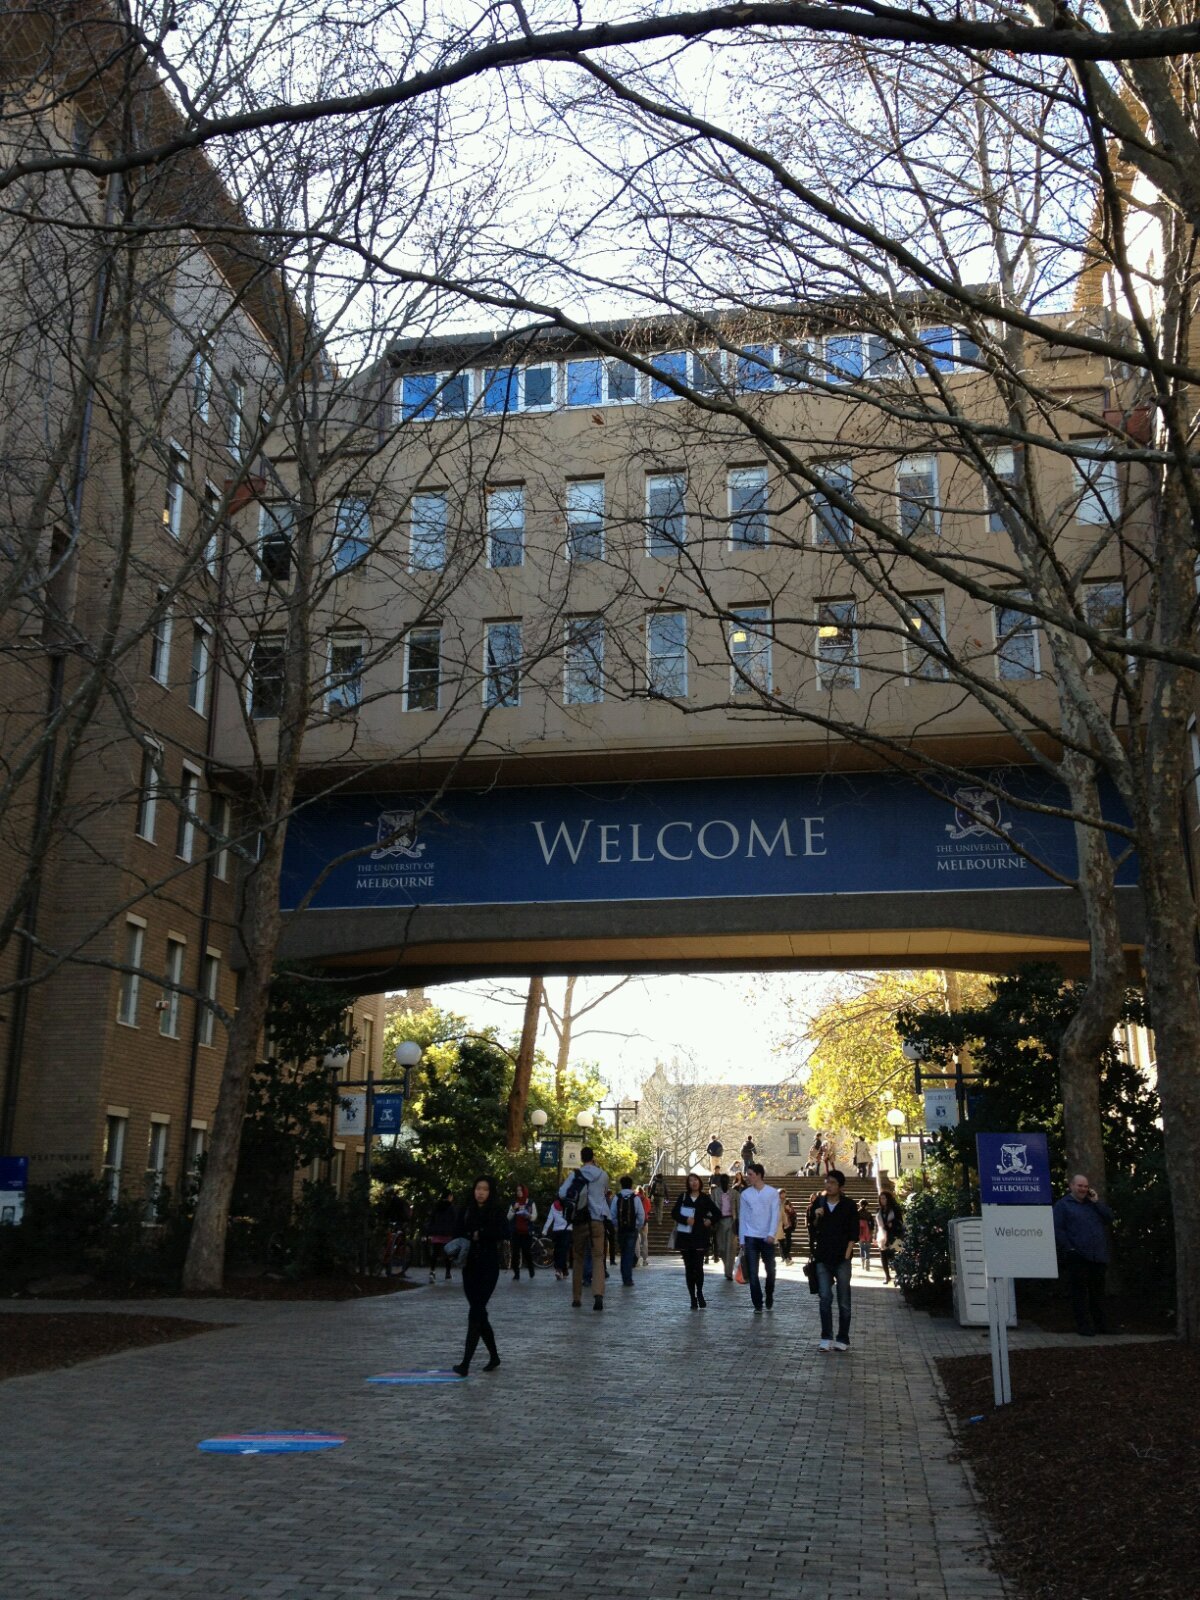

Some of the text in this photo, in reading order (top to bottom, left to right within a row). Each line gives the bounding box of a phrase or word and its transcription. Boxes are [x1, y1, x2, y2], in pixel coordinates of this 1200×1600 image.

[530, 816, 828, 866] WELCOME
[955, 843, 1009, 852] UNIVERSITY
[374, 863, 422, 872] UNIVERSITY
[936, 857, 1027, 871] MELBOURNE
[356, 876, 435, 889] MELBOURNE
[995, 1227, 1043, 1237] Welcome
